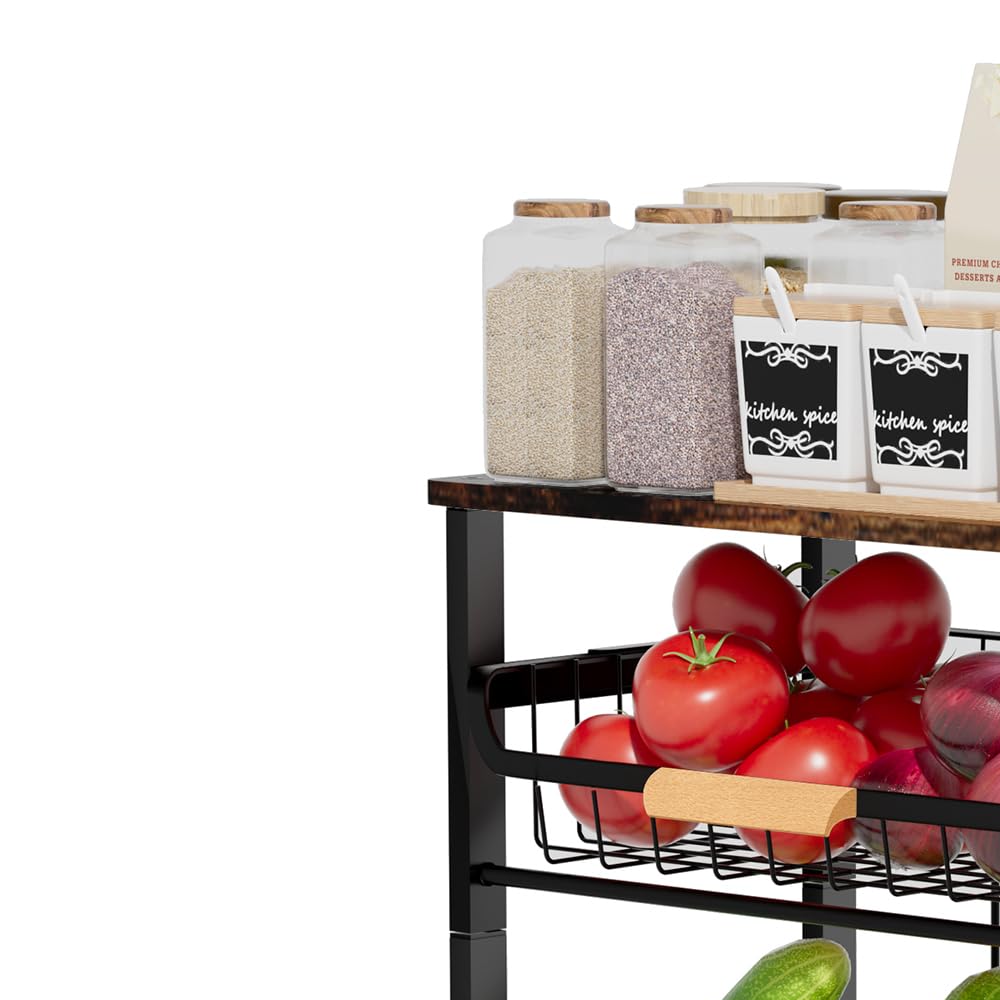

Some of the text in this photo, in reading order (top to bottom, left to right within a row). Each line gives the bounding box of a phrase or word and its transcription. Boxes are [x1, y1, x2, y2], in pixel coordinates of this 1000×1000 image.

[951, 258, 989, 268] PREMIUM
[954, 272, 994, 283] DESSERTS
[745, 401, 838, 428] kitchen spice
[873, 410, 968, 437] kitchen spice
